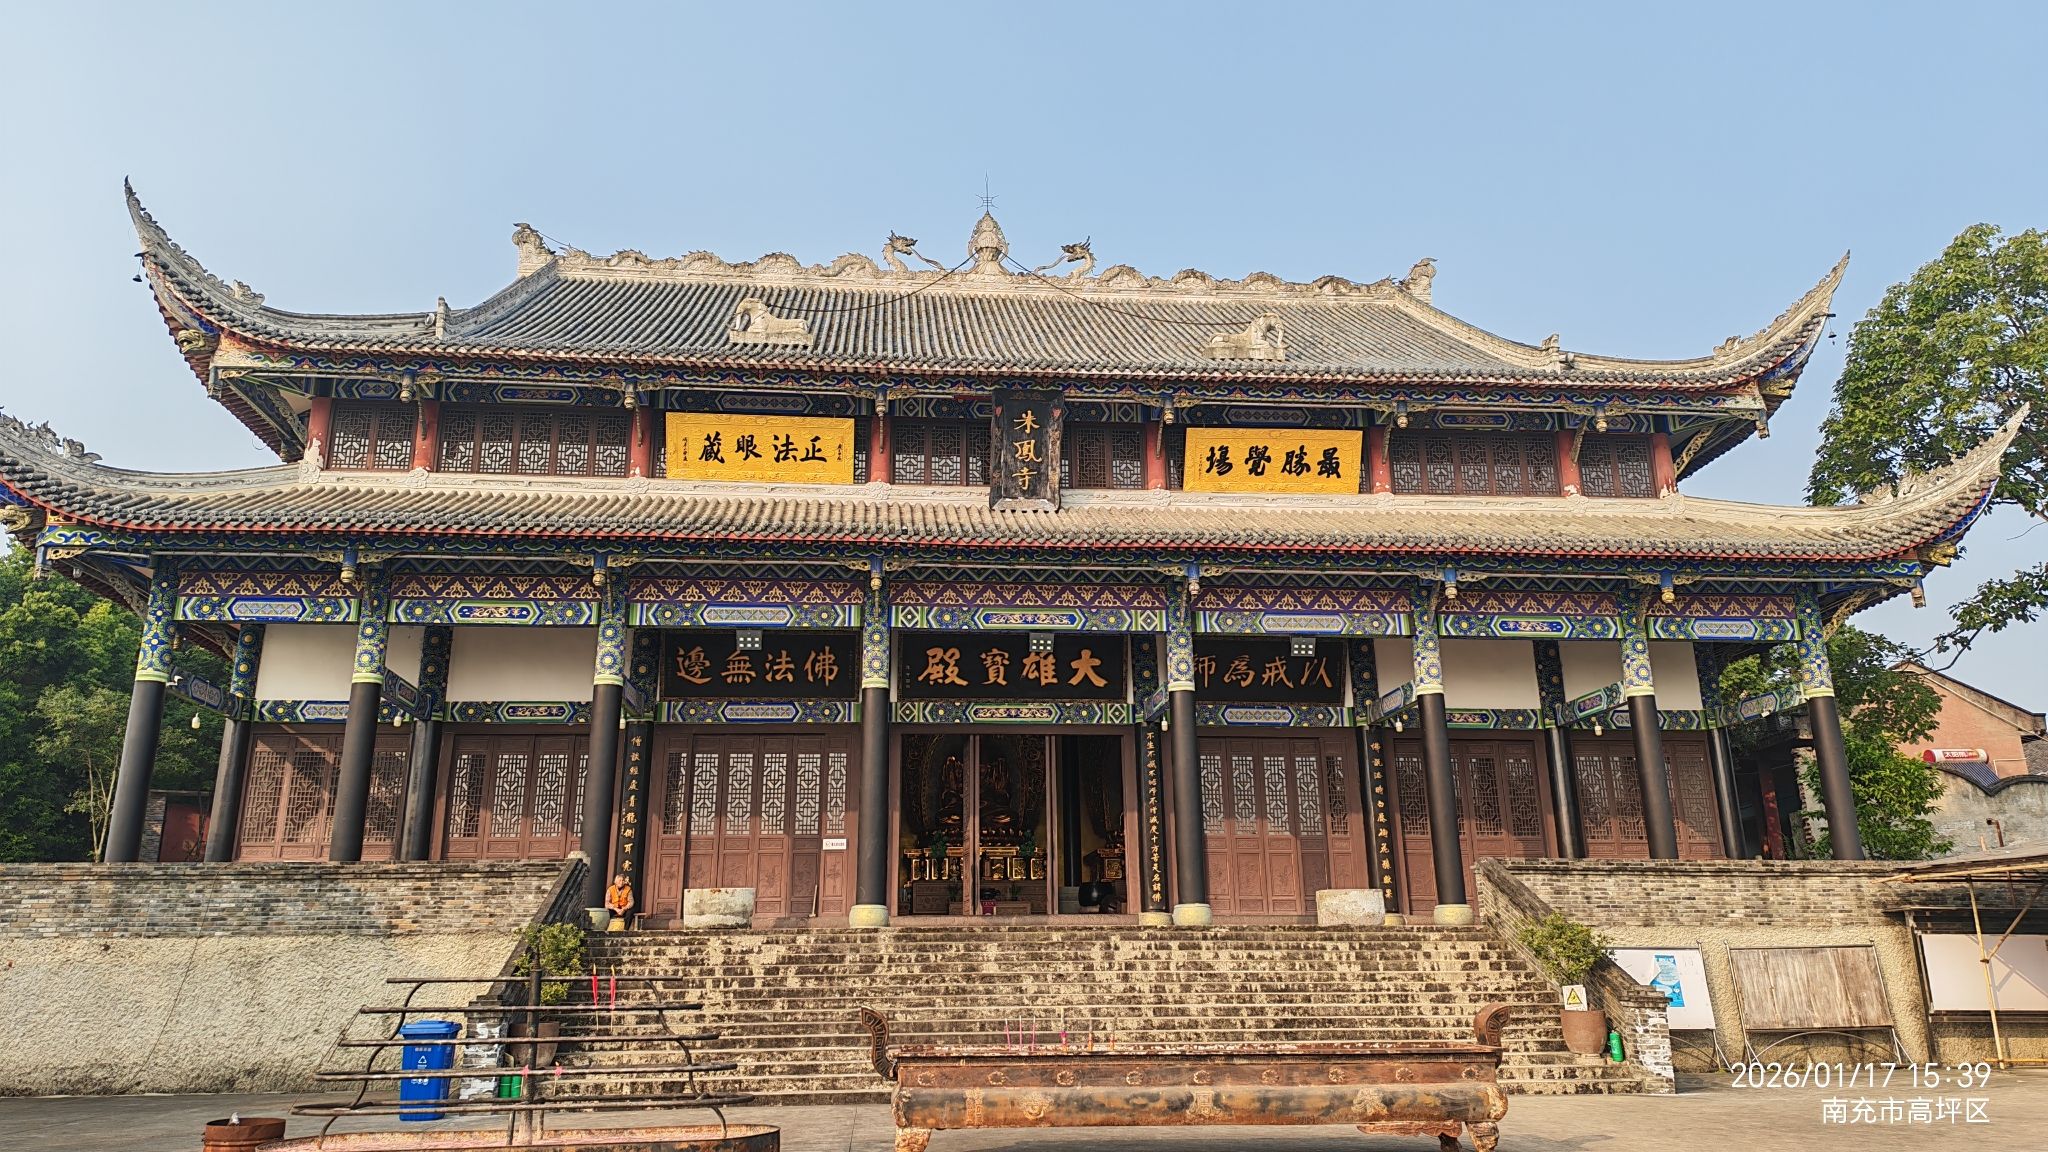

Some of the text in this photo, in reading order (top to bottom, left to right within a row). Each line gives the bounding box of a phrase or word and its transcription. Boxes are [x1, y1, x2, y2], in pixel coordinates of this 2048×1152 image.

[676, 645, 840, 687] 佛法無邊
[917, 646, 1109, 688] 大雄寶殿
